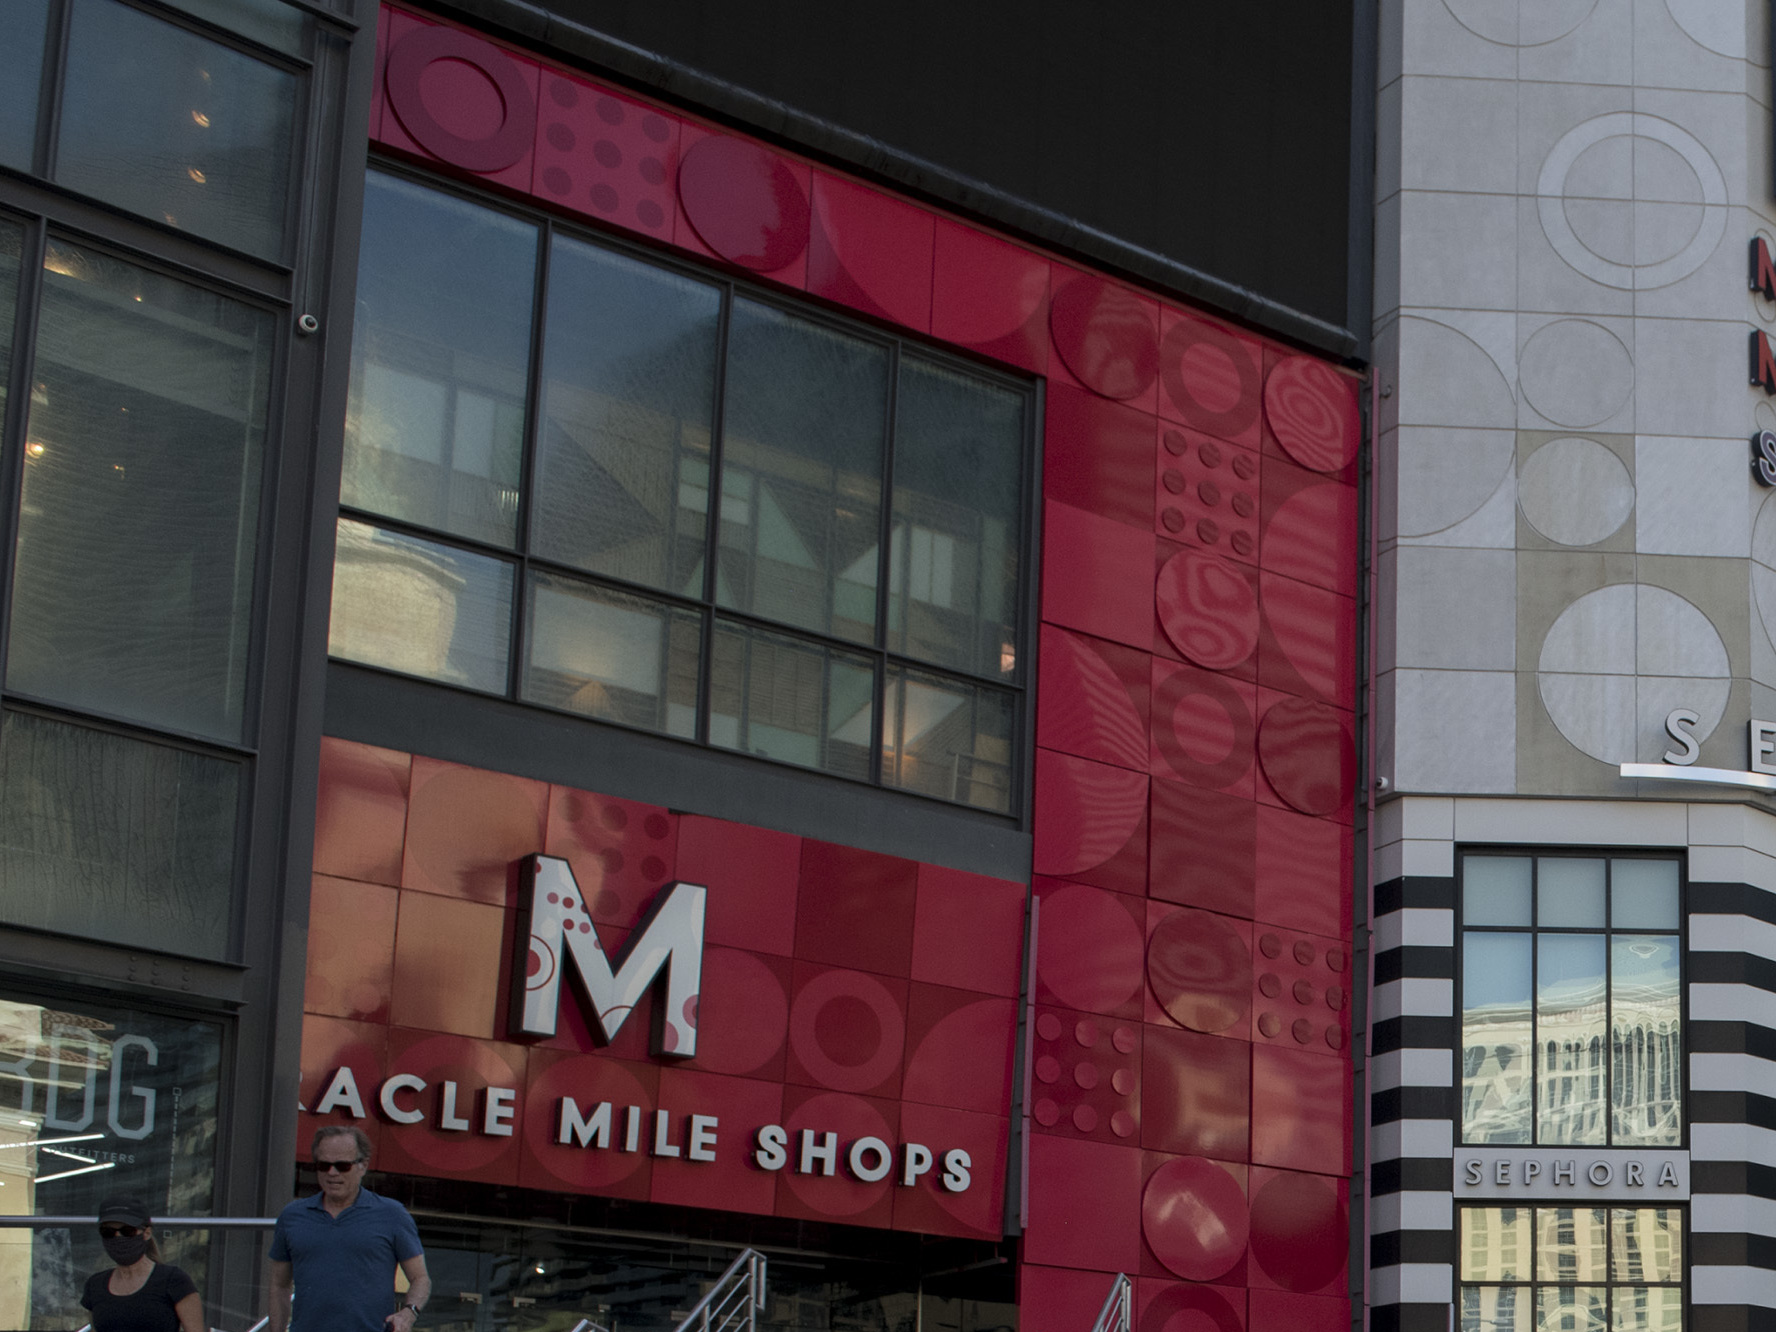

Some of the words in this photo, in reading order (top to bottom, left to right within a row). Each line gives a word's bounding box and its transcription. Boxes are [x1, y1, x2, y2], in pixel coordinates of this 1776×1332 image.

[508, 853, 708, 1060] M
[299, 1066, 516, 1137] ACLE
[554, 1096, 718, 1162] MILE
[751, 1124, 972, 1192] SHOPS
[1465, 1159, 1679, 1187] SEPHORA
